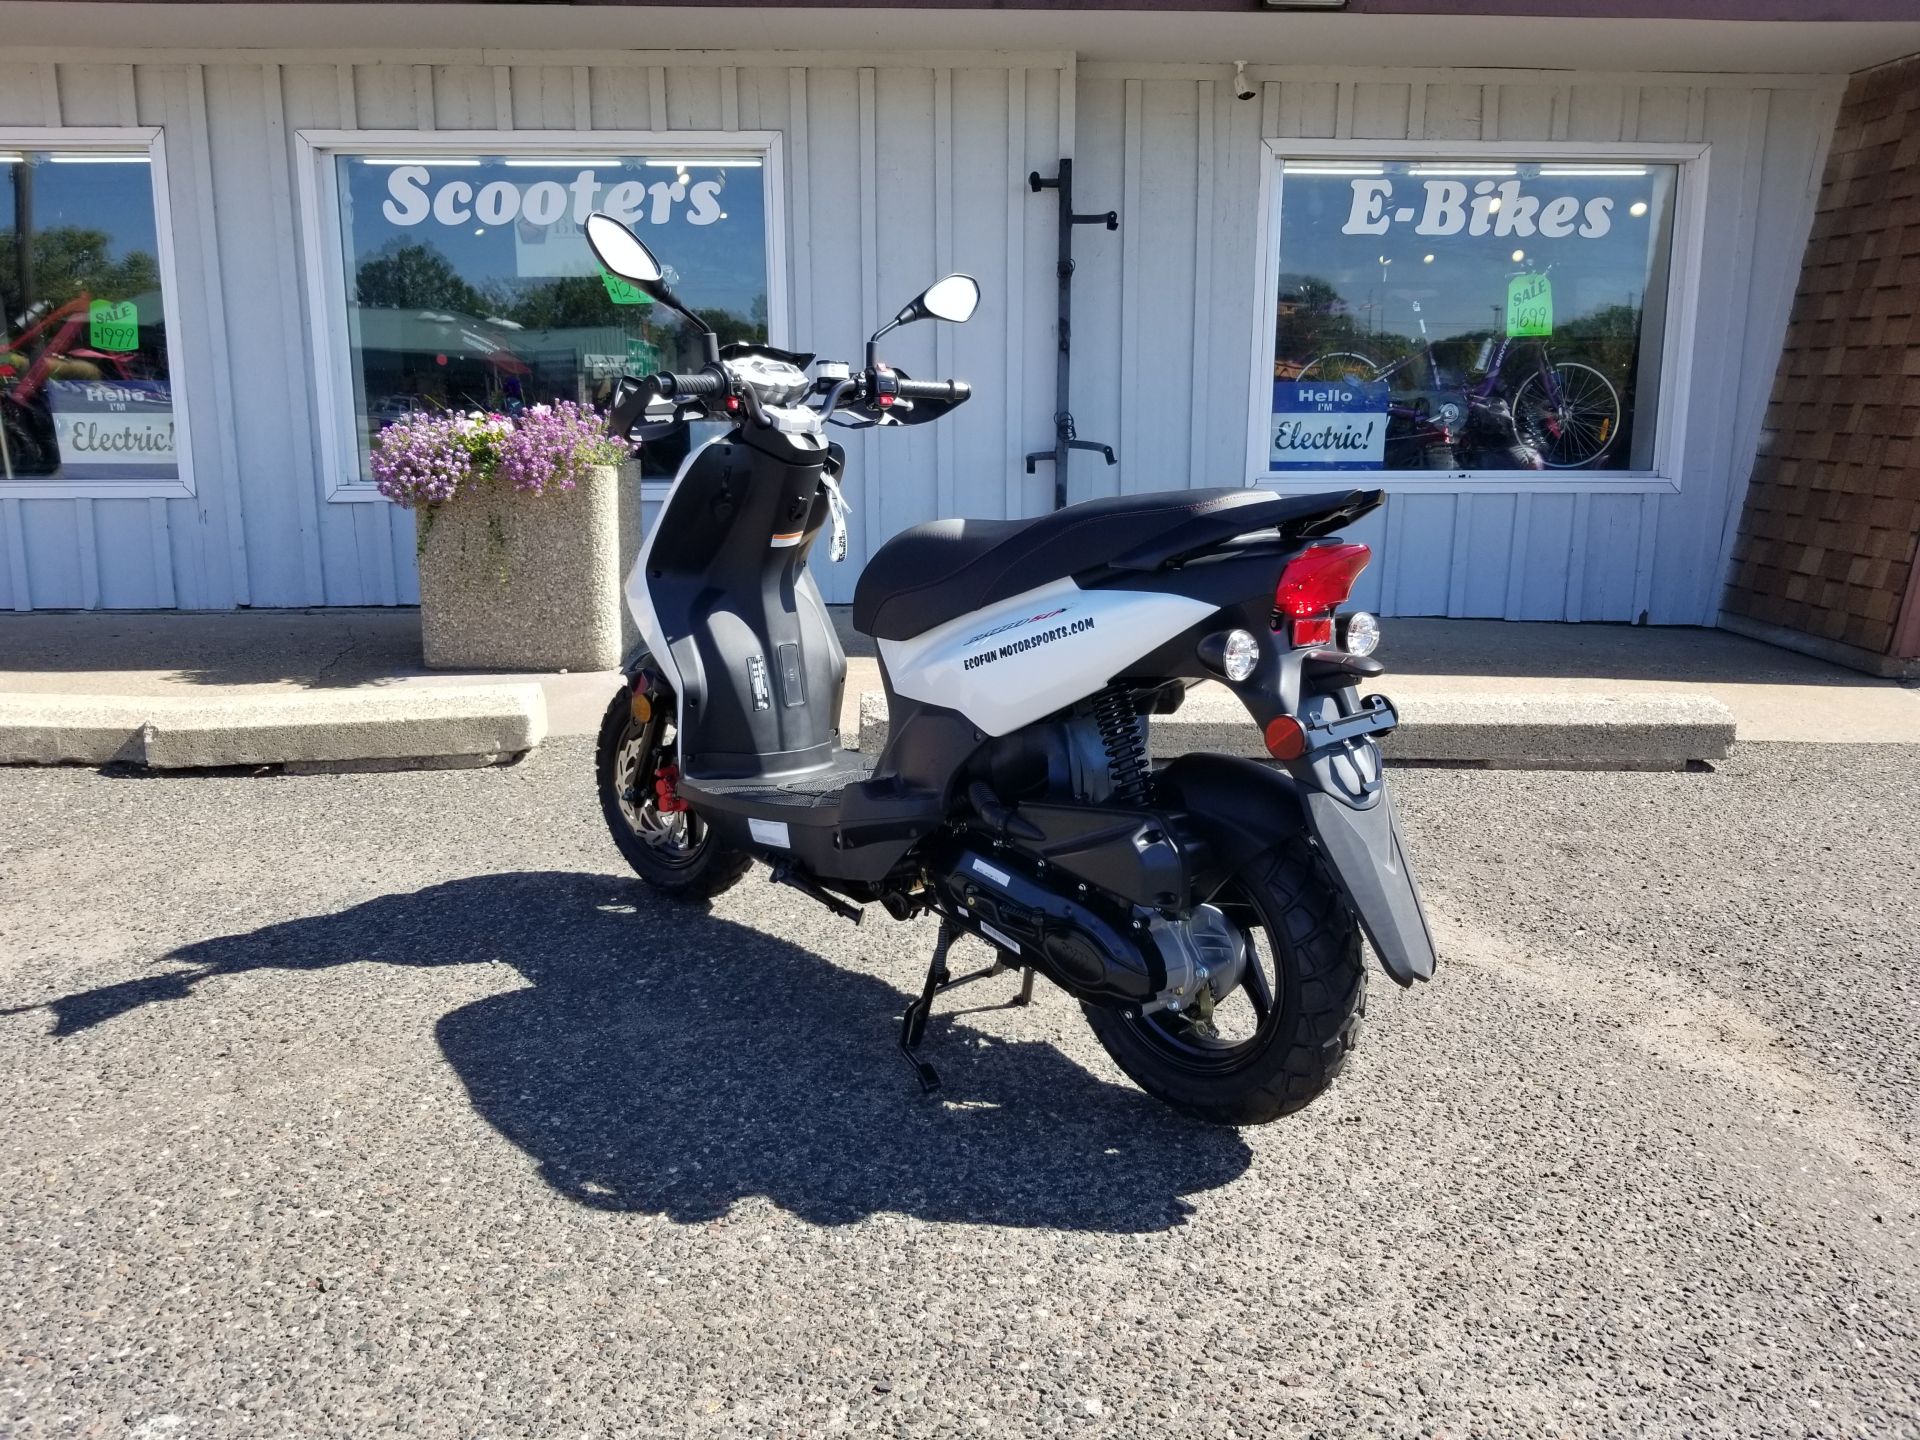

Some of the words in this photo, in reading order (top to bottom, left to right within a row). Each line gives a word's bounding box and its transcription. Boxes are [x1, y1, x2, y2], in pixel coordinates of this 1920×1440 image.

[383, 166, 721, 225] Scooters
[1341, 179, 1614, 238] E-Bikes
[1513, 280, 1547, 307] SALE
[95, 305, 131, 325] SALE
[1511, 307, 1546, 328] $1699
[94, 327, 135, 348] $1999
[87, 388, 145, 402] Hello
[1298, 389, 1353, 402] Hello
[109, 402, 126, 411] I'M
[1317, 403, 1333, 412] I'M
[1274, 421, 1374, 450] Electric!
[963, 650, 998, 671] ECOFUN
[999, 617, 1095, 659] MOTORSPORTS.COM
